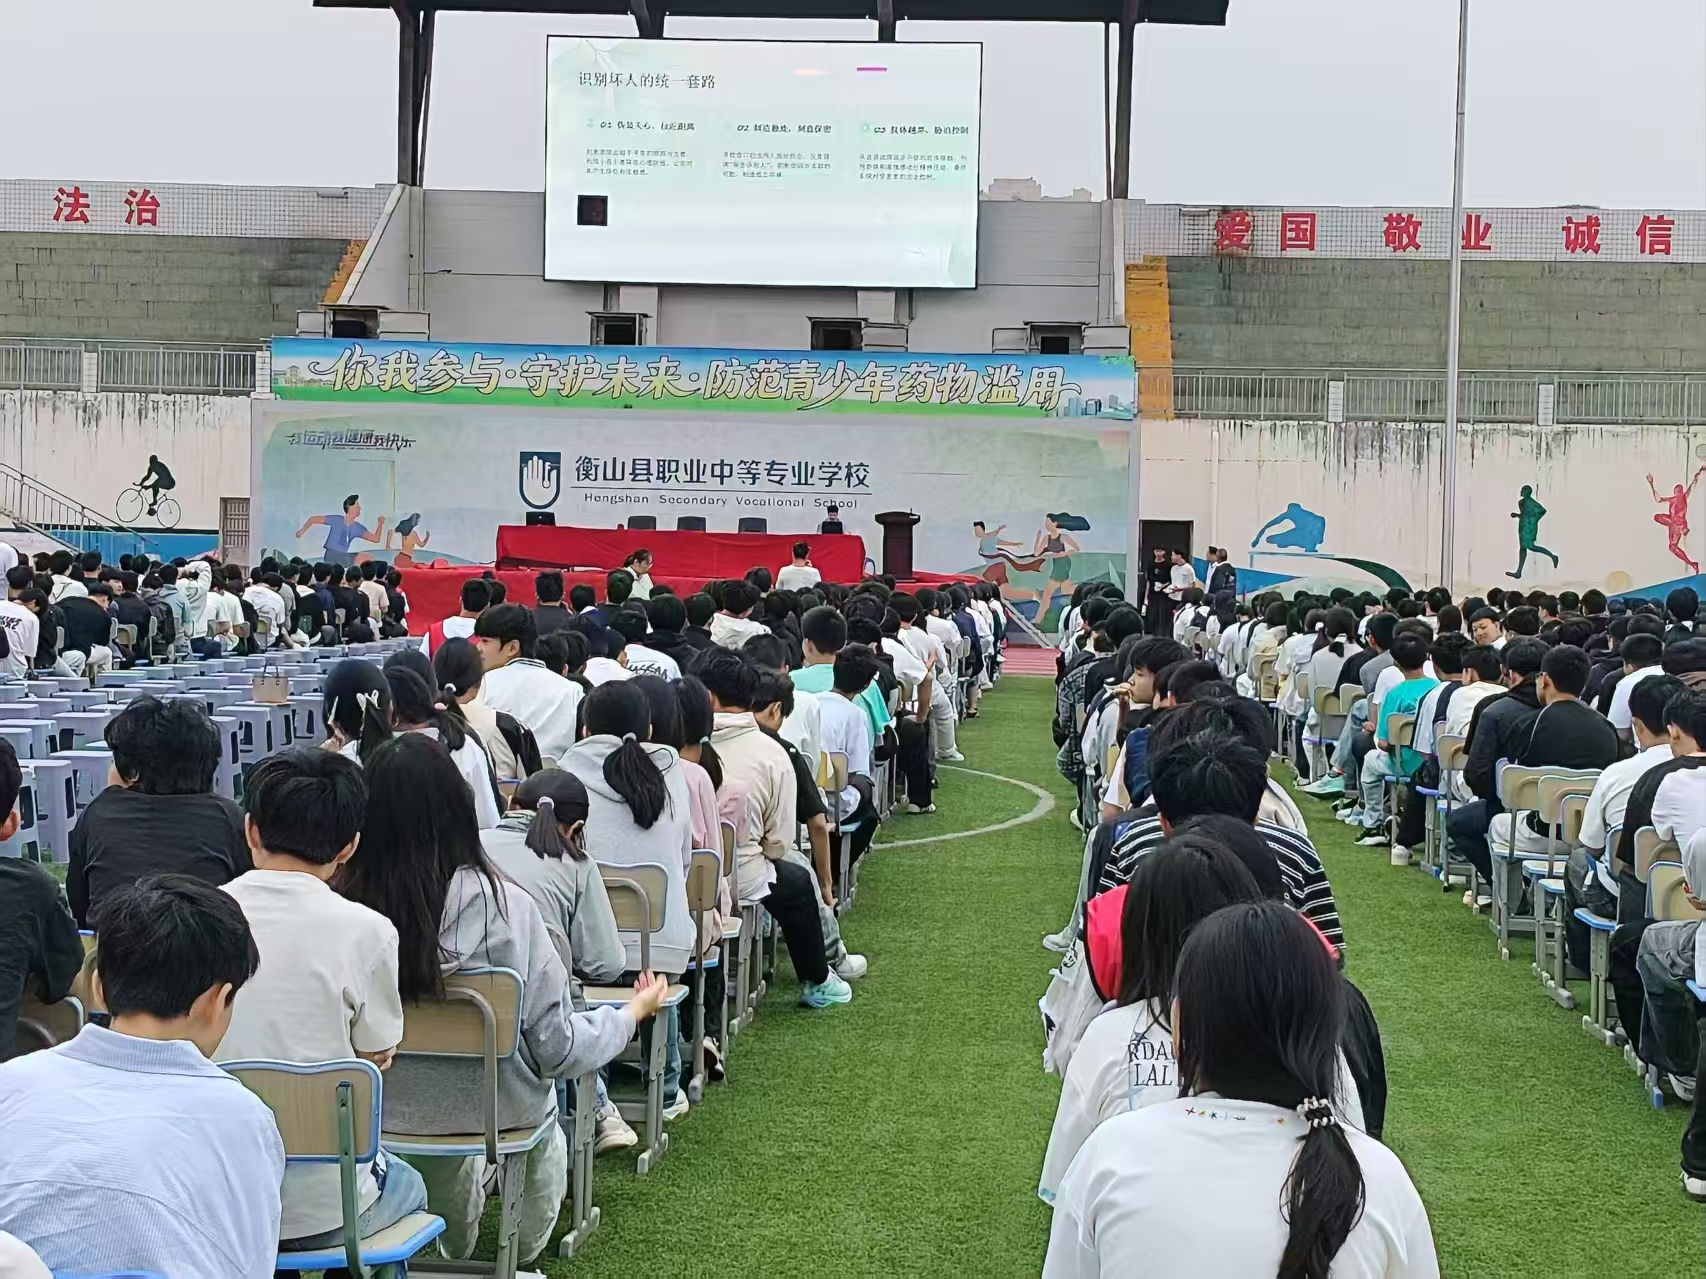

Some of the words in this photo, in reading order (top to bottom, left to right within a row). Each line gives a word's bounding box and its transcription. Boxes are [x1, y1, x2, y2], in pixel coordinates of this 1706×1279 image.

[579, 71, 716, 89] 识别坏人的统一套路
[53, 186, 160, 226] 法治
[1215, 211, 1316, 252] 爱国
[1383, 213, 1492, 253] 敬业
[1562, 215, 1676, 255] 诚信
[575, 455, 870, 488] 衡山县职业中等专业学校
[659, 494, 728, 507] Secondary
[736, 496, 804, 507] Vocational
[814, 498, 857, 509] School
